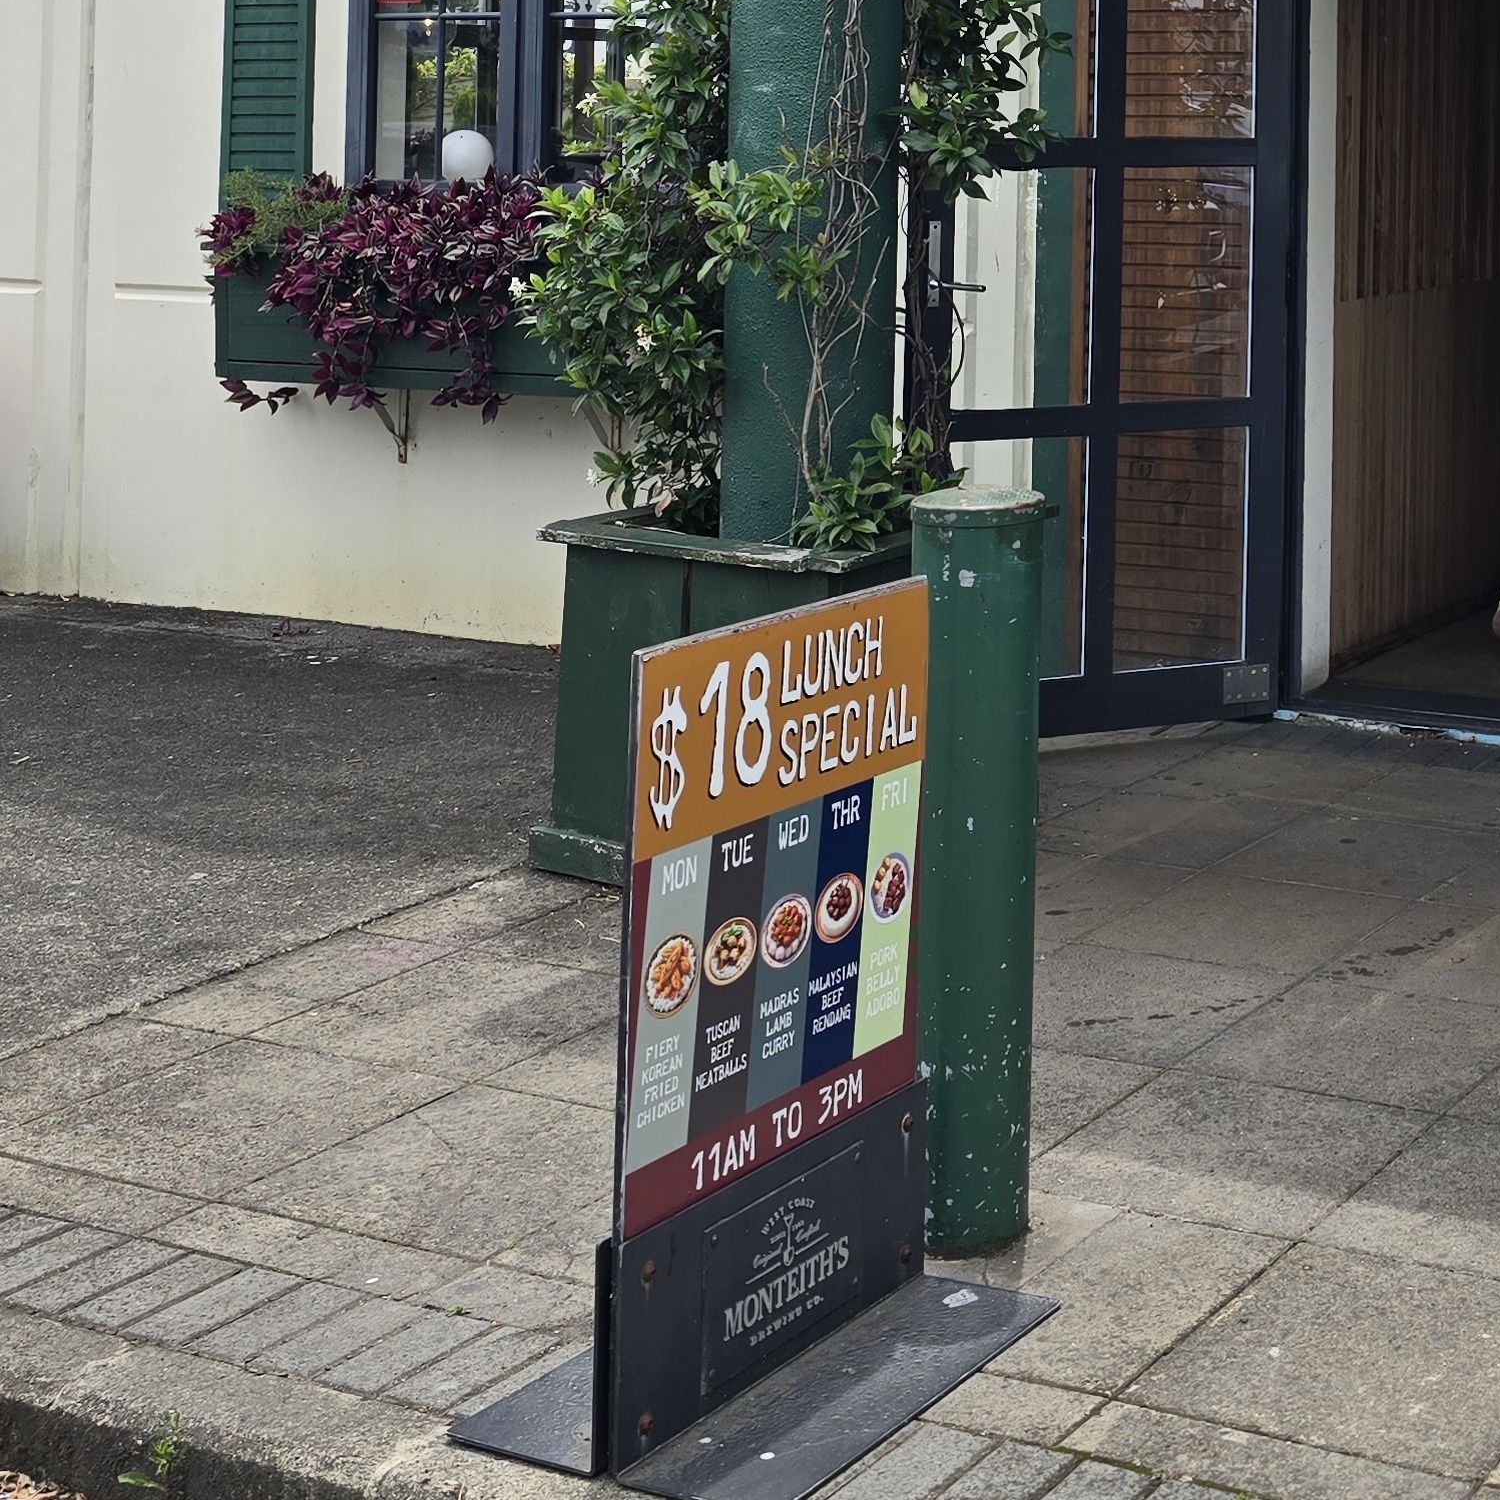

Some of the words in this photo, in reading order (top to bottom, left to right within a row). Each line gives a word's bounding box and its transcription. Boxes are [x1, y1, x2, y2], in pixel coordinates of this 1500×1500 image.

[649, 651, 772, 830] $18
[781, 615, 884, 704] LUNCH
[777, 683, 918, 786] SPECIAL
[831, 794, 861, 830] THR
[881, 776, 909, 812] FRI
[778, 813, 810, 851] WED
[721, 833, 754, 872] TUE
[661, 854, 698, 895] MON
[869, 943, 899, 971] PORK
[808, 960, 859, 998] MALAYSIAN
[866, 963, 901, 995] BELLY
[759, 987, 800, 1020] MADRAS
[821, 986, 844, 1011] BEEF
[865, 987, 901, 1020] ADOBO
[705, 1014, 742, 1045] TUSCAN
[765, 1012, 793, 1038] LAMB
[812, 1003, 851, 1035] RENDANG
[645, 1033, 681, 1061] FIERY
[710, 1038, 735, 1064] BEEF
[762, 1030, 796, 1060] CURRY
[641, 1053, 683, 1086] KOREAN
[695, 1053, 748, 1093] MEATBALLS
[643, 1076, 679, 1106] FRIED
[636, 1093, 686, 1129] CHICKEN
[690, 1123, 755, 1191] 11AM
[772, 1100, 803, 1149] TO
[817, 1068, 863, 1125] 3PM
[761, 1206, 785, 1236] WEST
[787, 1197, 816, 1211] COAST
[722, 1235, 850, 1342] MONTEITH'S
[748, 1305, 803, 1347] BREWING
